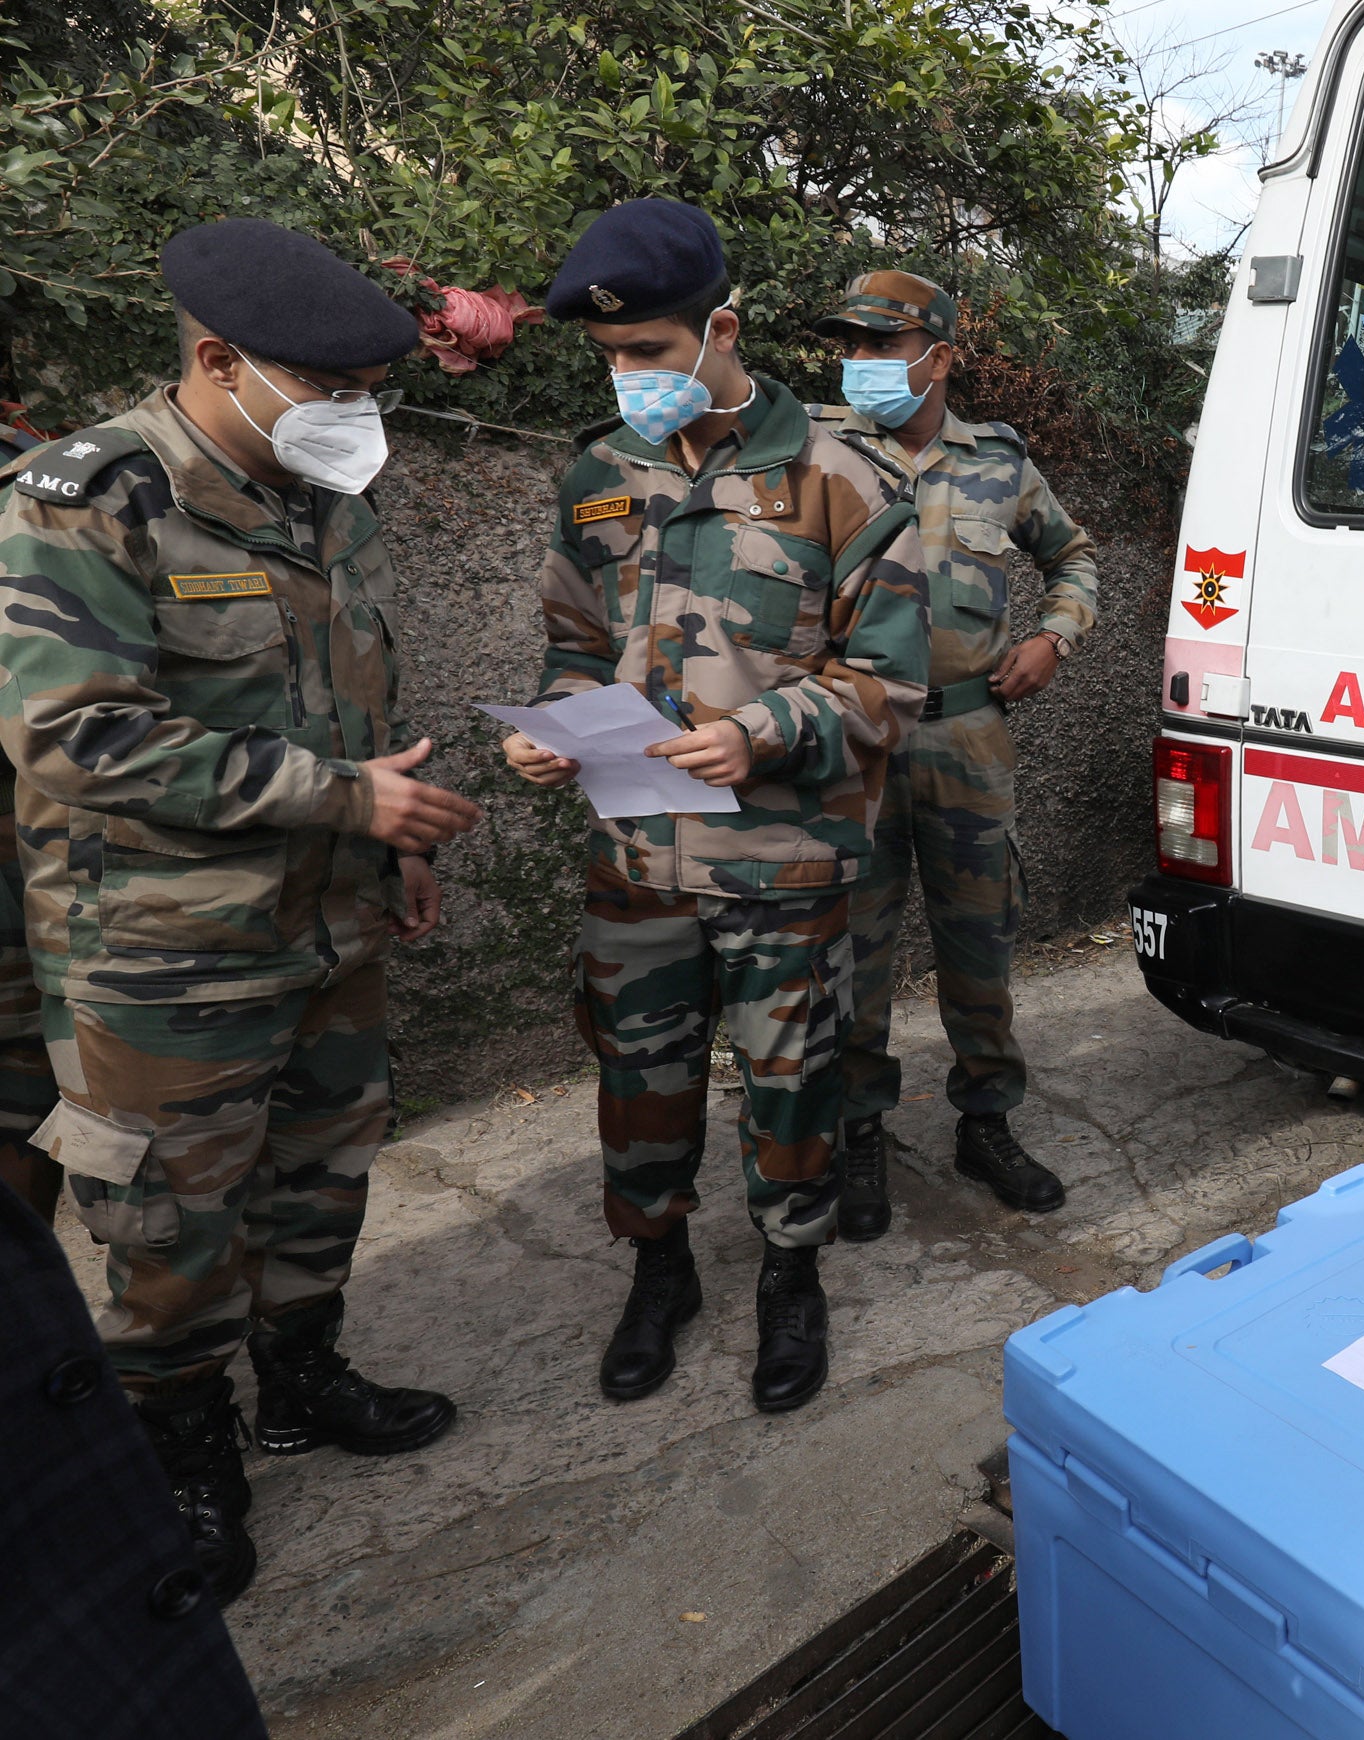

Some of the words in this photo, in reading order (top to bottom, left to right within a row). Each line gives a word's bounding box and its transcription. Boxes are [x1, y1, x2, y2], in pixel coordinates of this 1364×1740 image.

[17, 470, 79, 497] AMC
[580, 501, 625, 518] SHUBHAM
[227, 578, 266, 591] TIWARI
[1250, 704, 1313, 734] TATA
[1127, 902, 1168, 960] 557
